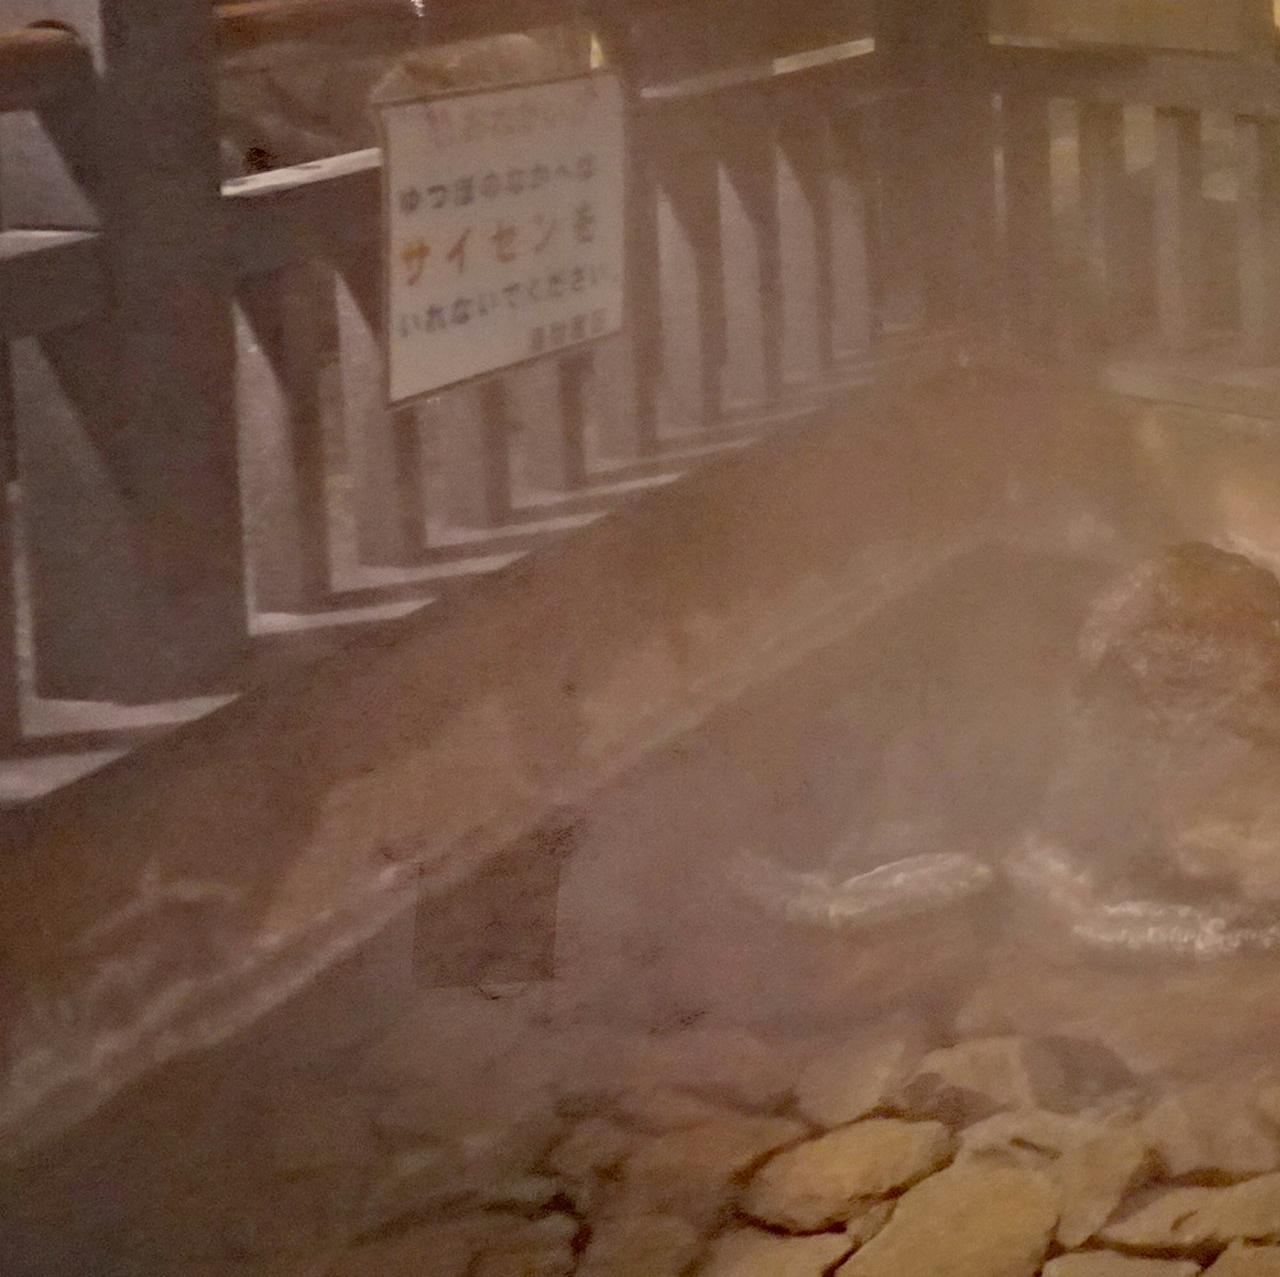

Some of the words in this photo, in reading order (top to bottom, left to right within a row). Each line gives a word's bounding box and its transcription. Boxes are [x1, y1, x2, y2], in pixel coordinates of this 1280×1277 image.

[401, 201, 596, 287] サイセンを
